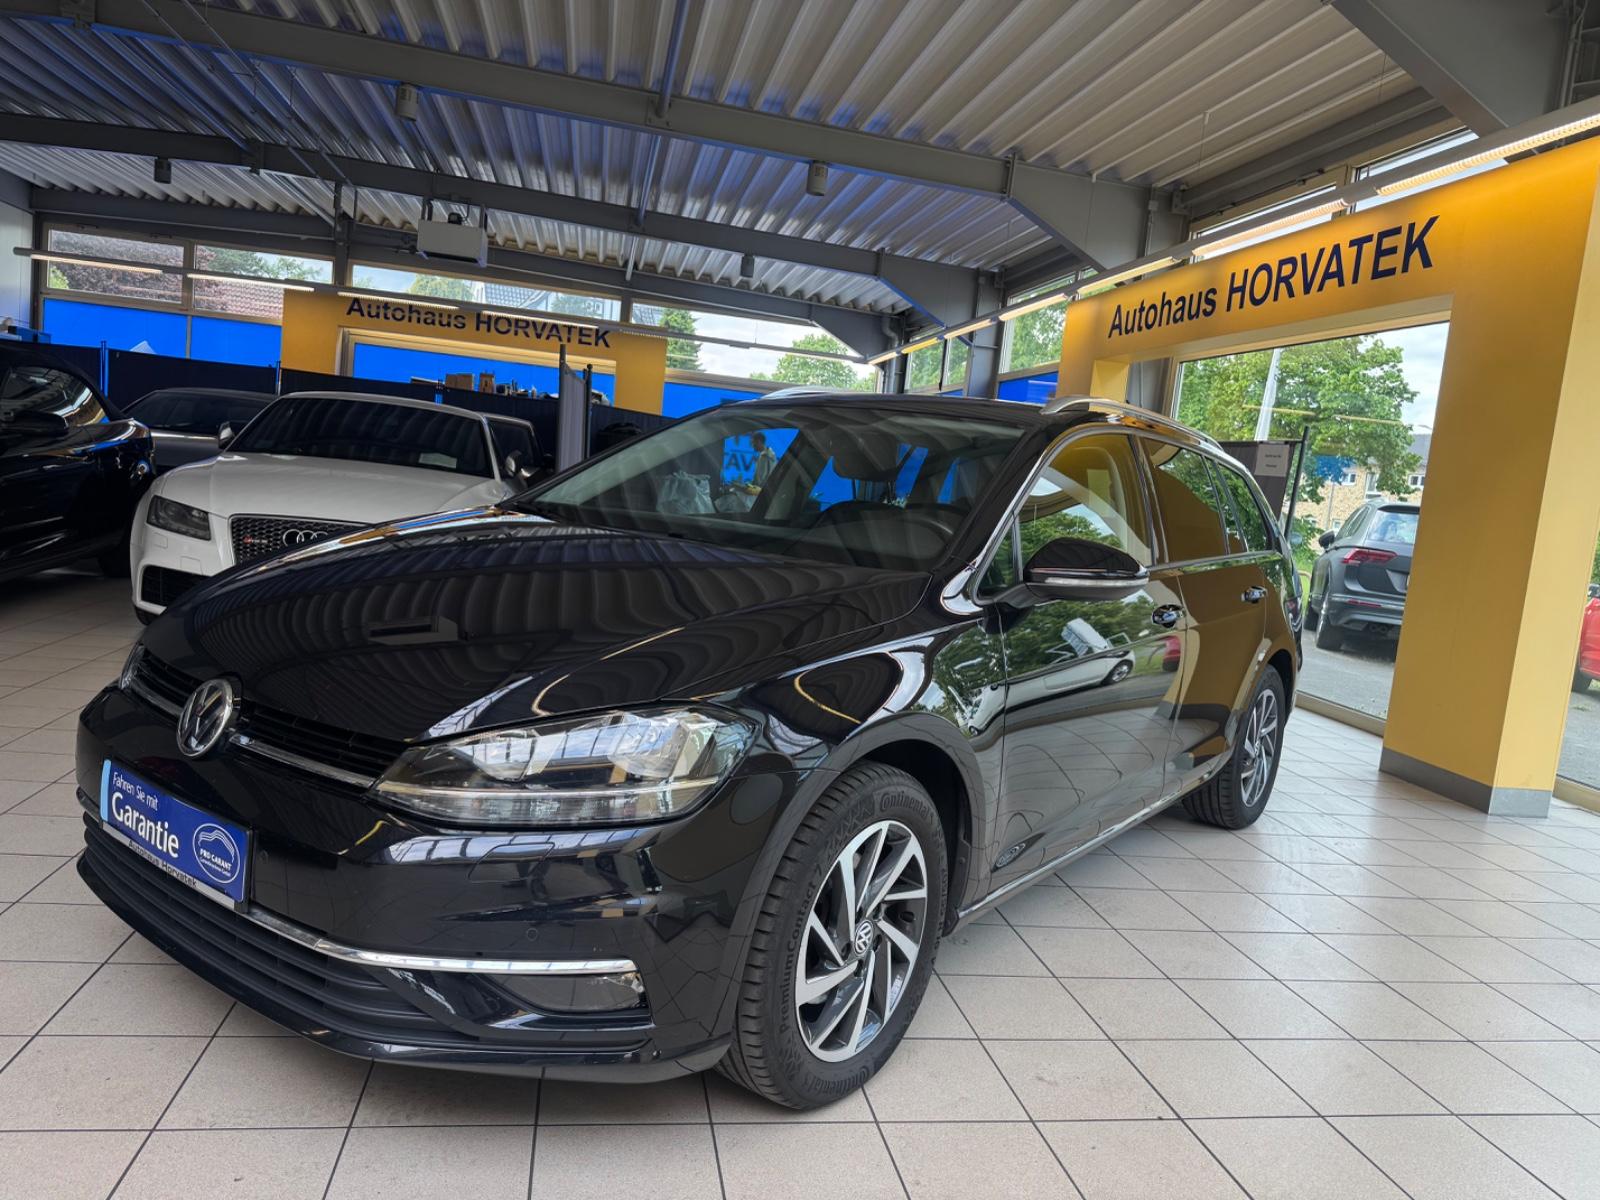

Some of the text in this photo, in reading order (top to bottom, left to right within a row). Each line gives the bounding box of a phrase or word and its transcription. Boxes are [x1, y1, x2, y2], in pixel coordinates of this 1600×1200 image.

[1108, 215, 1439, 338] Autohaus HORVATEK
[346, 297, 610, 348] Autohaus HORVATEK
[112, 791, 179, 858] Garantie
[113, 771, 158, 811] Fahren Sie mit
[779, 881, 817, 1034] PremiumContact
